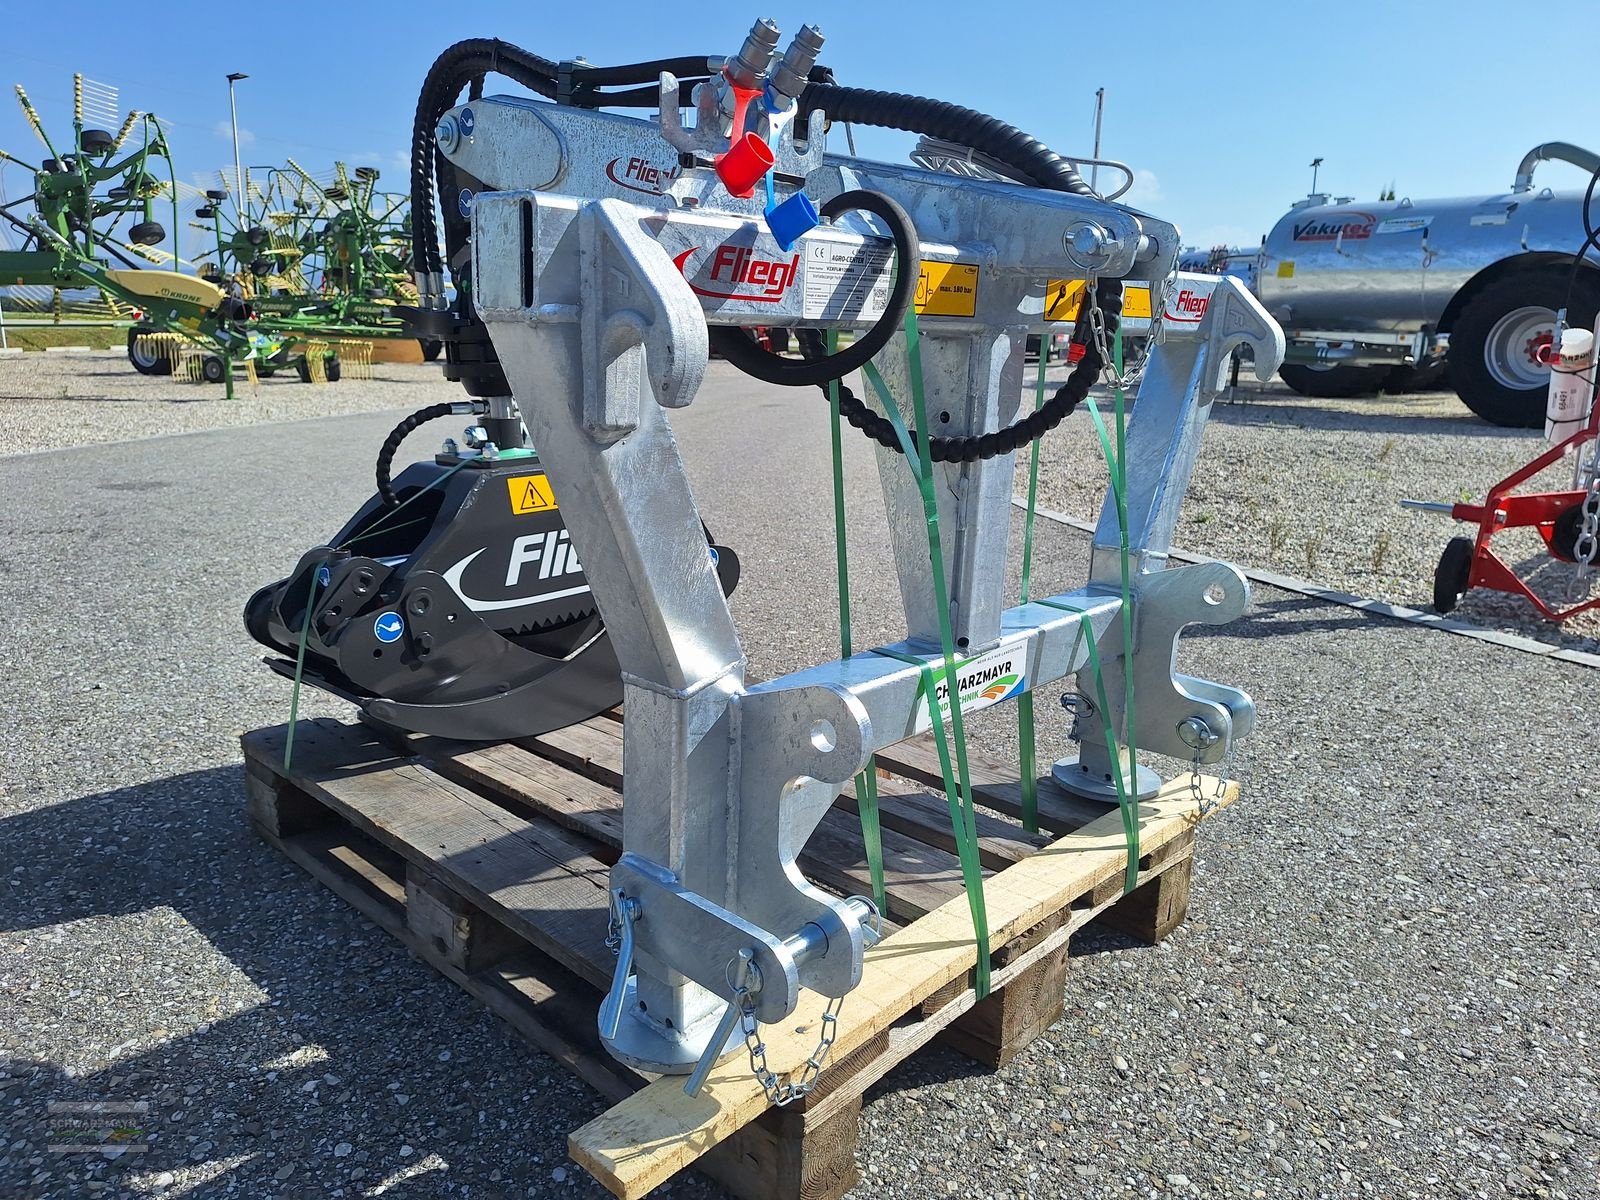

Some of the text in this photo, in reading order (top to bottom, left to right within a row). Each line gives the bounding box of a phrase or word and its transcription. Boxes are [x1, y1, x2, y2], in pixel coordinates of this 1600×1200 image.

[1293, 220, 1374, 241] Vakutec
[710, 245, 800, 295] Fliegl
[170, 291, 202, 302] KRONE
[964, 286, 972, 294] bar
[1176, 290, 1211, 318] Fliegl
[935, 661, 1012, 701] CHARZMAYR
